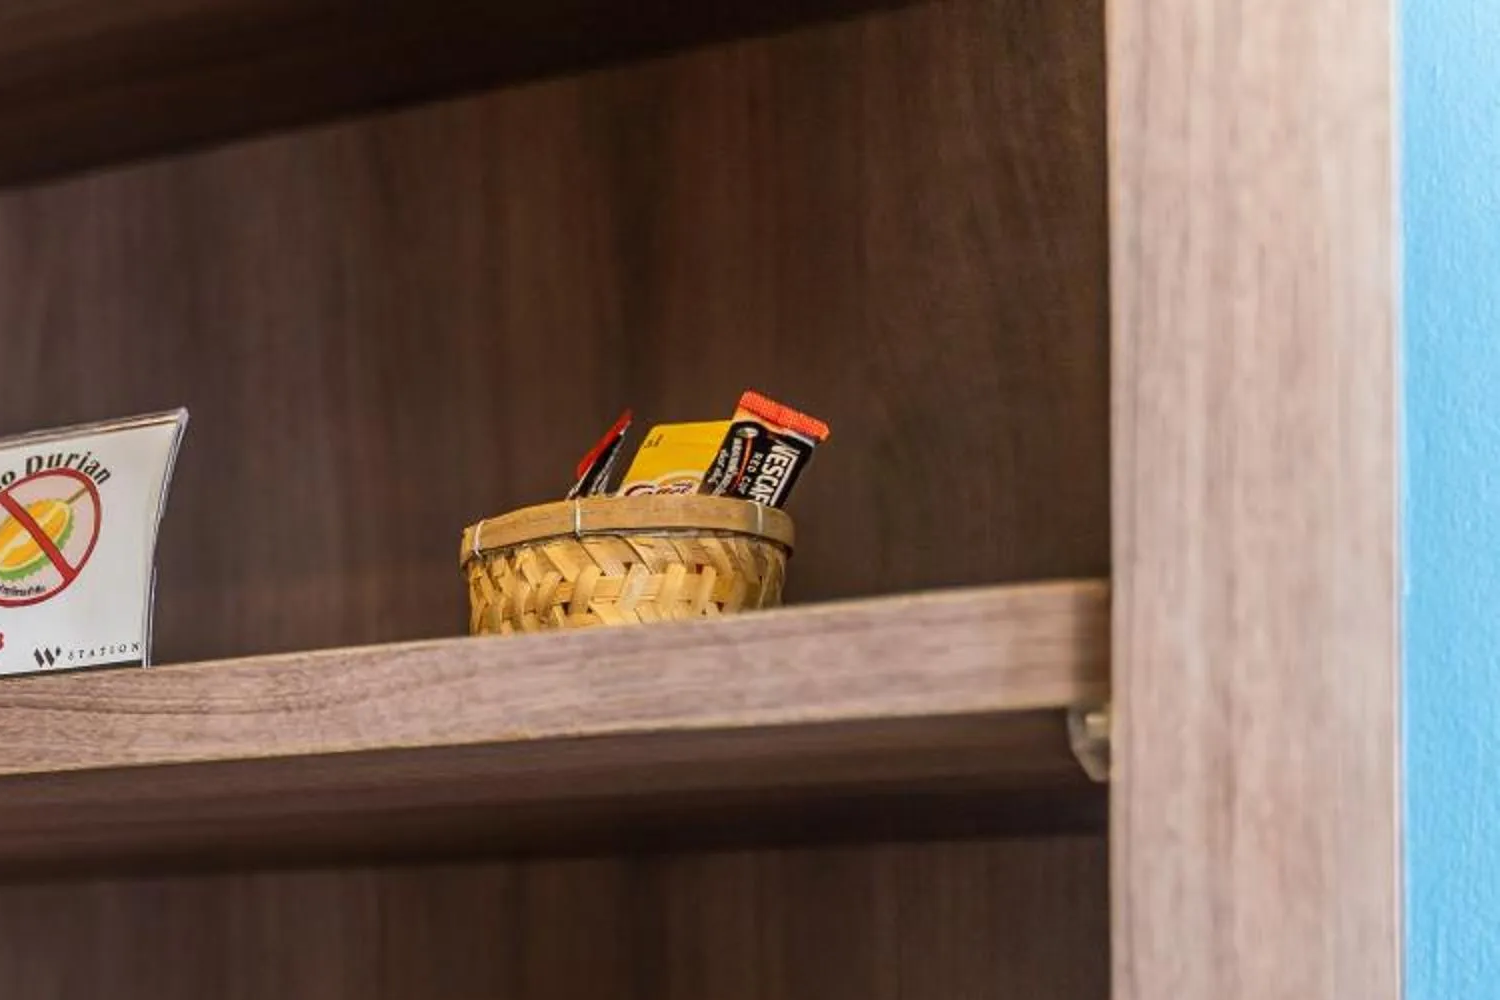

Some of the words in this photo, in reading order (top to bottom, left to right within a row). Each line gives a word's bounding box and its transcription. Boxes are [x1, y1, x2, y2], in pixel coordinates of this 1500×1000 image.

[25, 451, 111, 485] Durian
[749, 438, 801, 505] NESCAF
[68, 643, 140, 661] STATION
